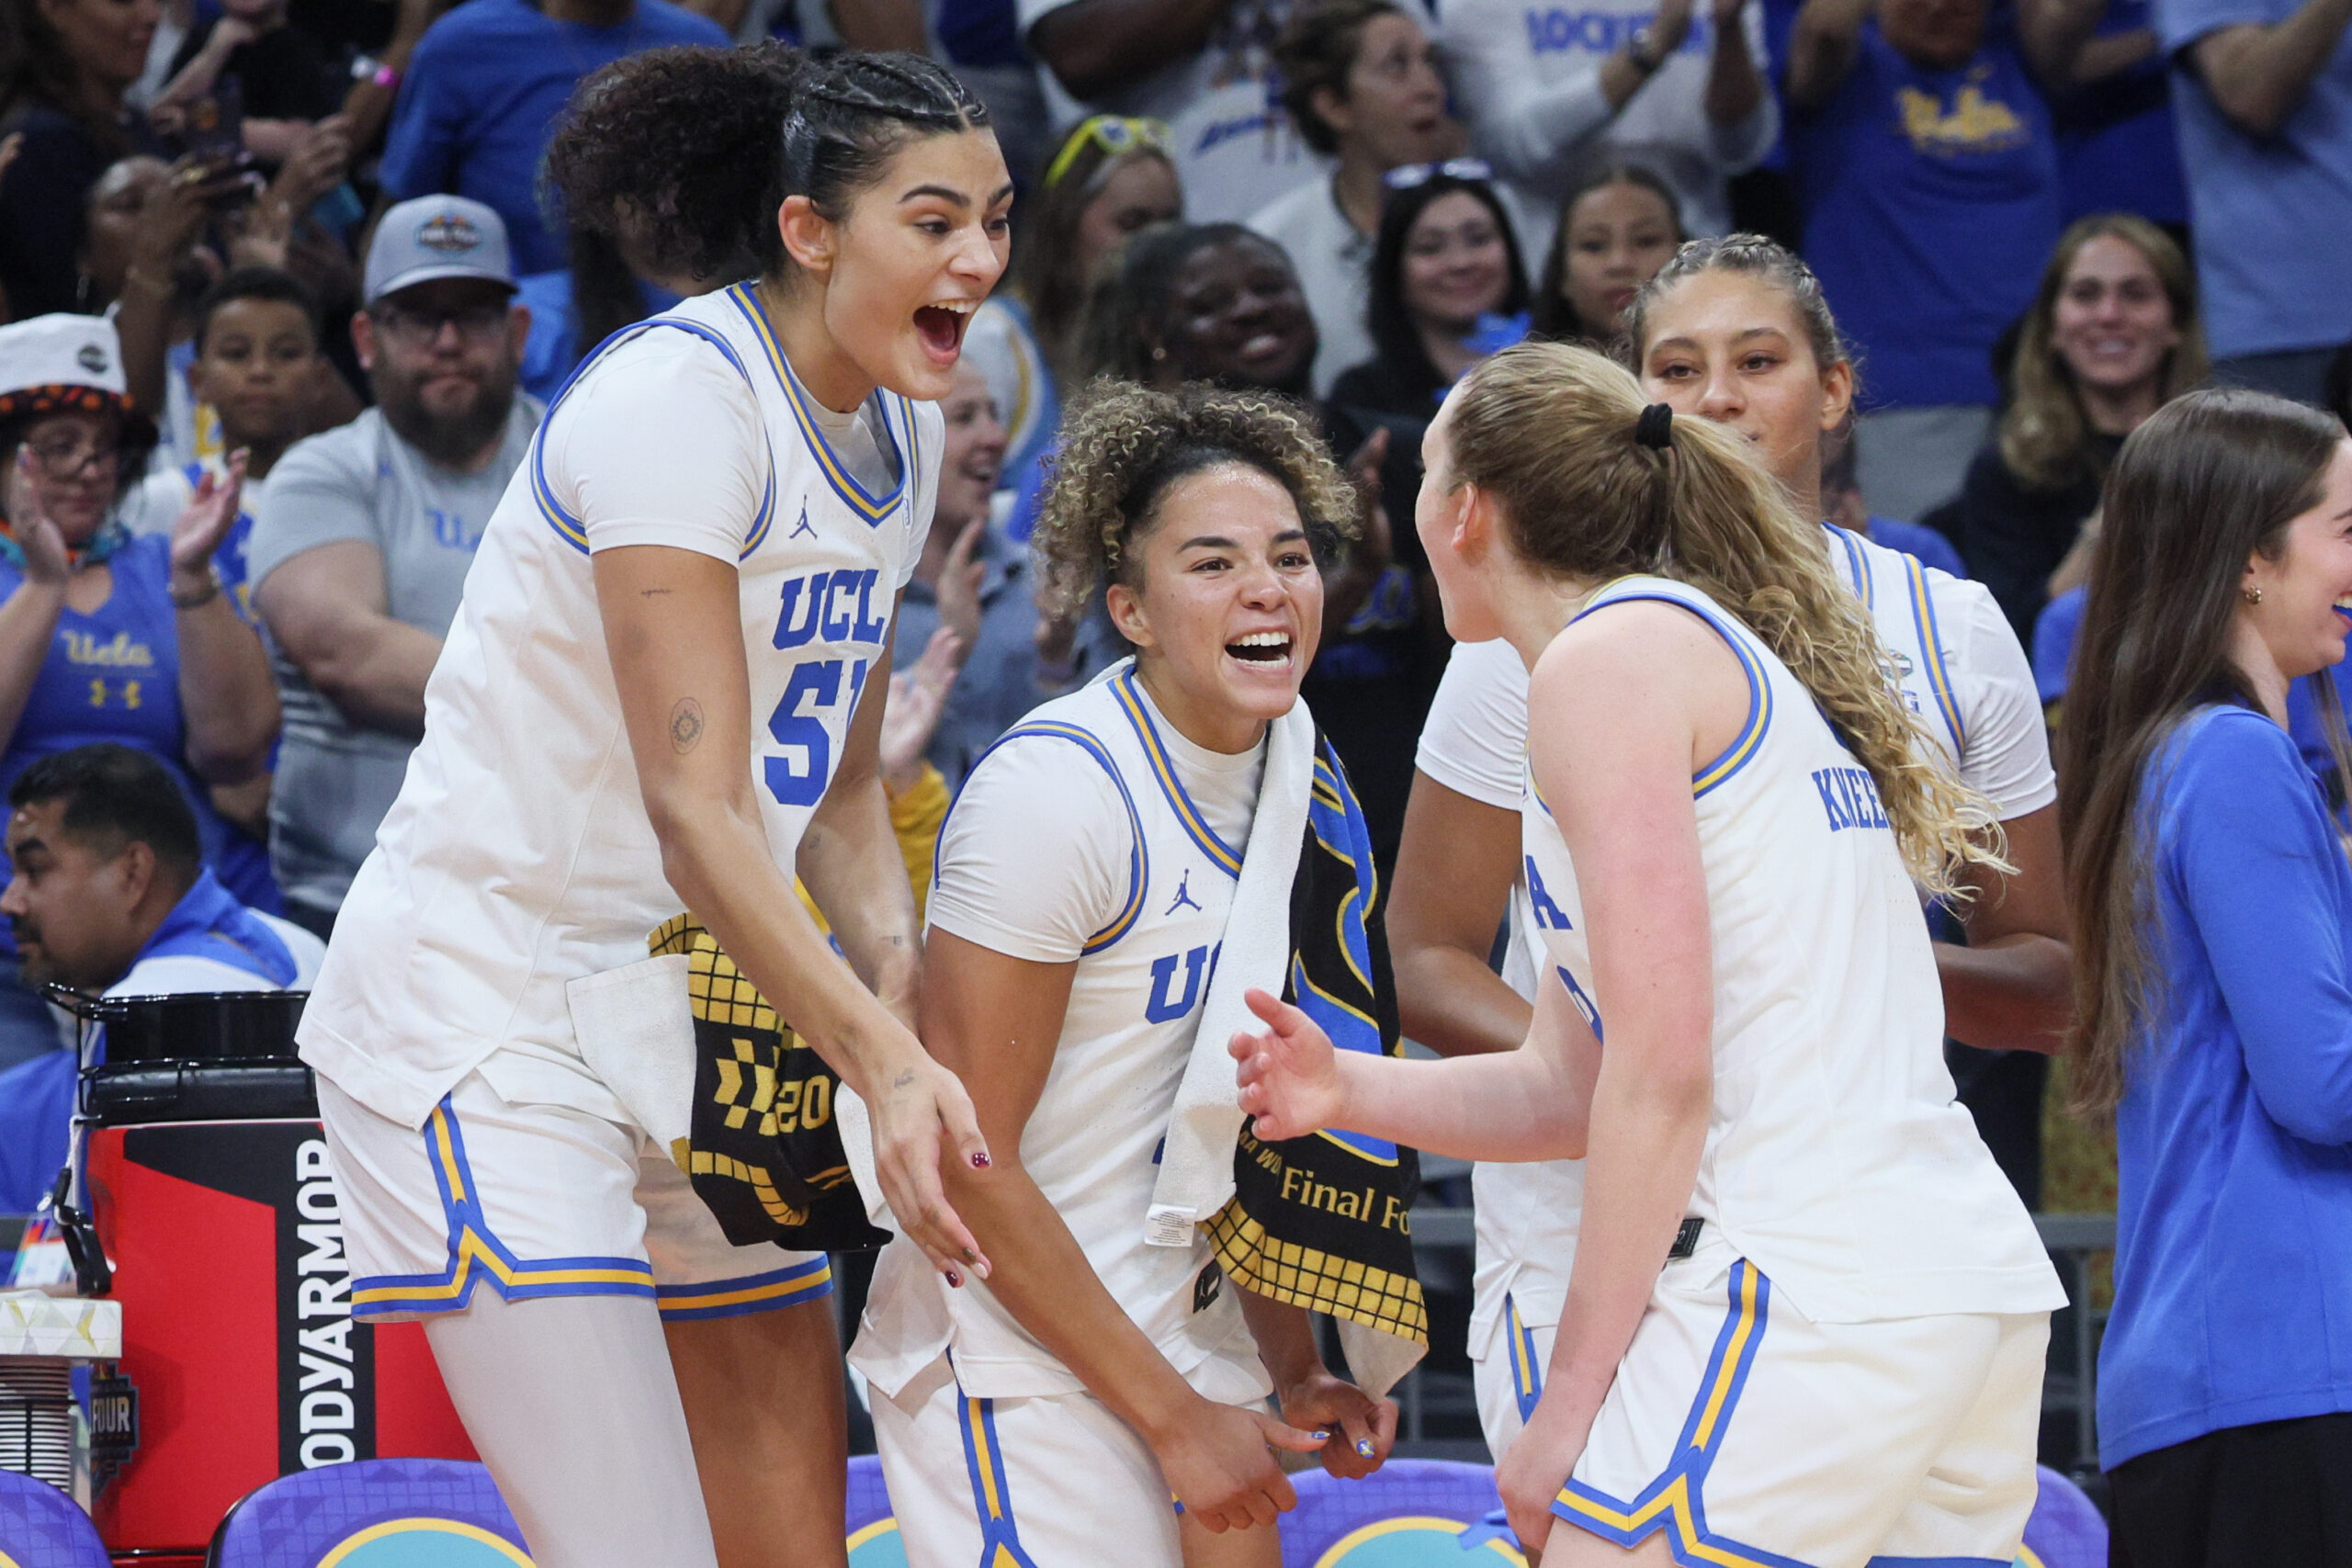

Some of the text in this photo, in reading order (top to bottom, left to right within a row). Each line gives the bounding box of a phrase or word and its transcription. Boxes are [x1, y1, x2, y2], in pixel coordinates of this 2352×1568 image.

[772, 568, 891, 650] UCL
[1811, 766, 1889, 832] KNEE
[1145, 940, 1223, 1025] U
[1281, 1167, 1375, 1223] Final
